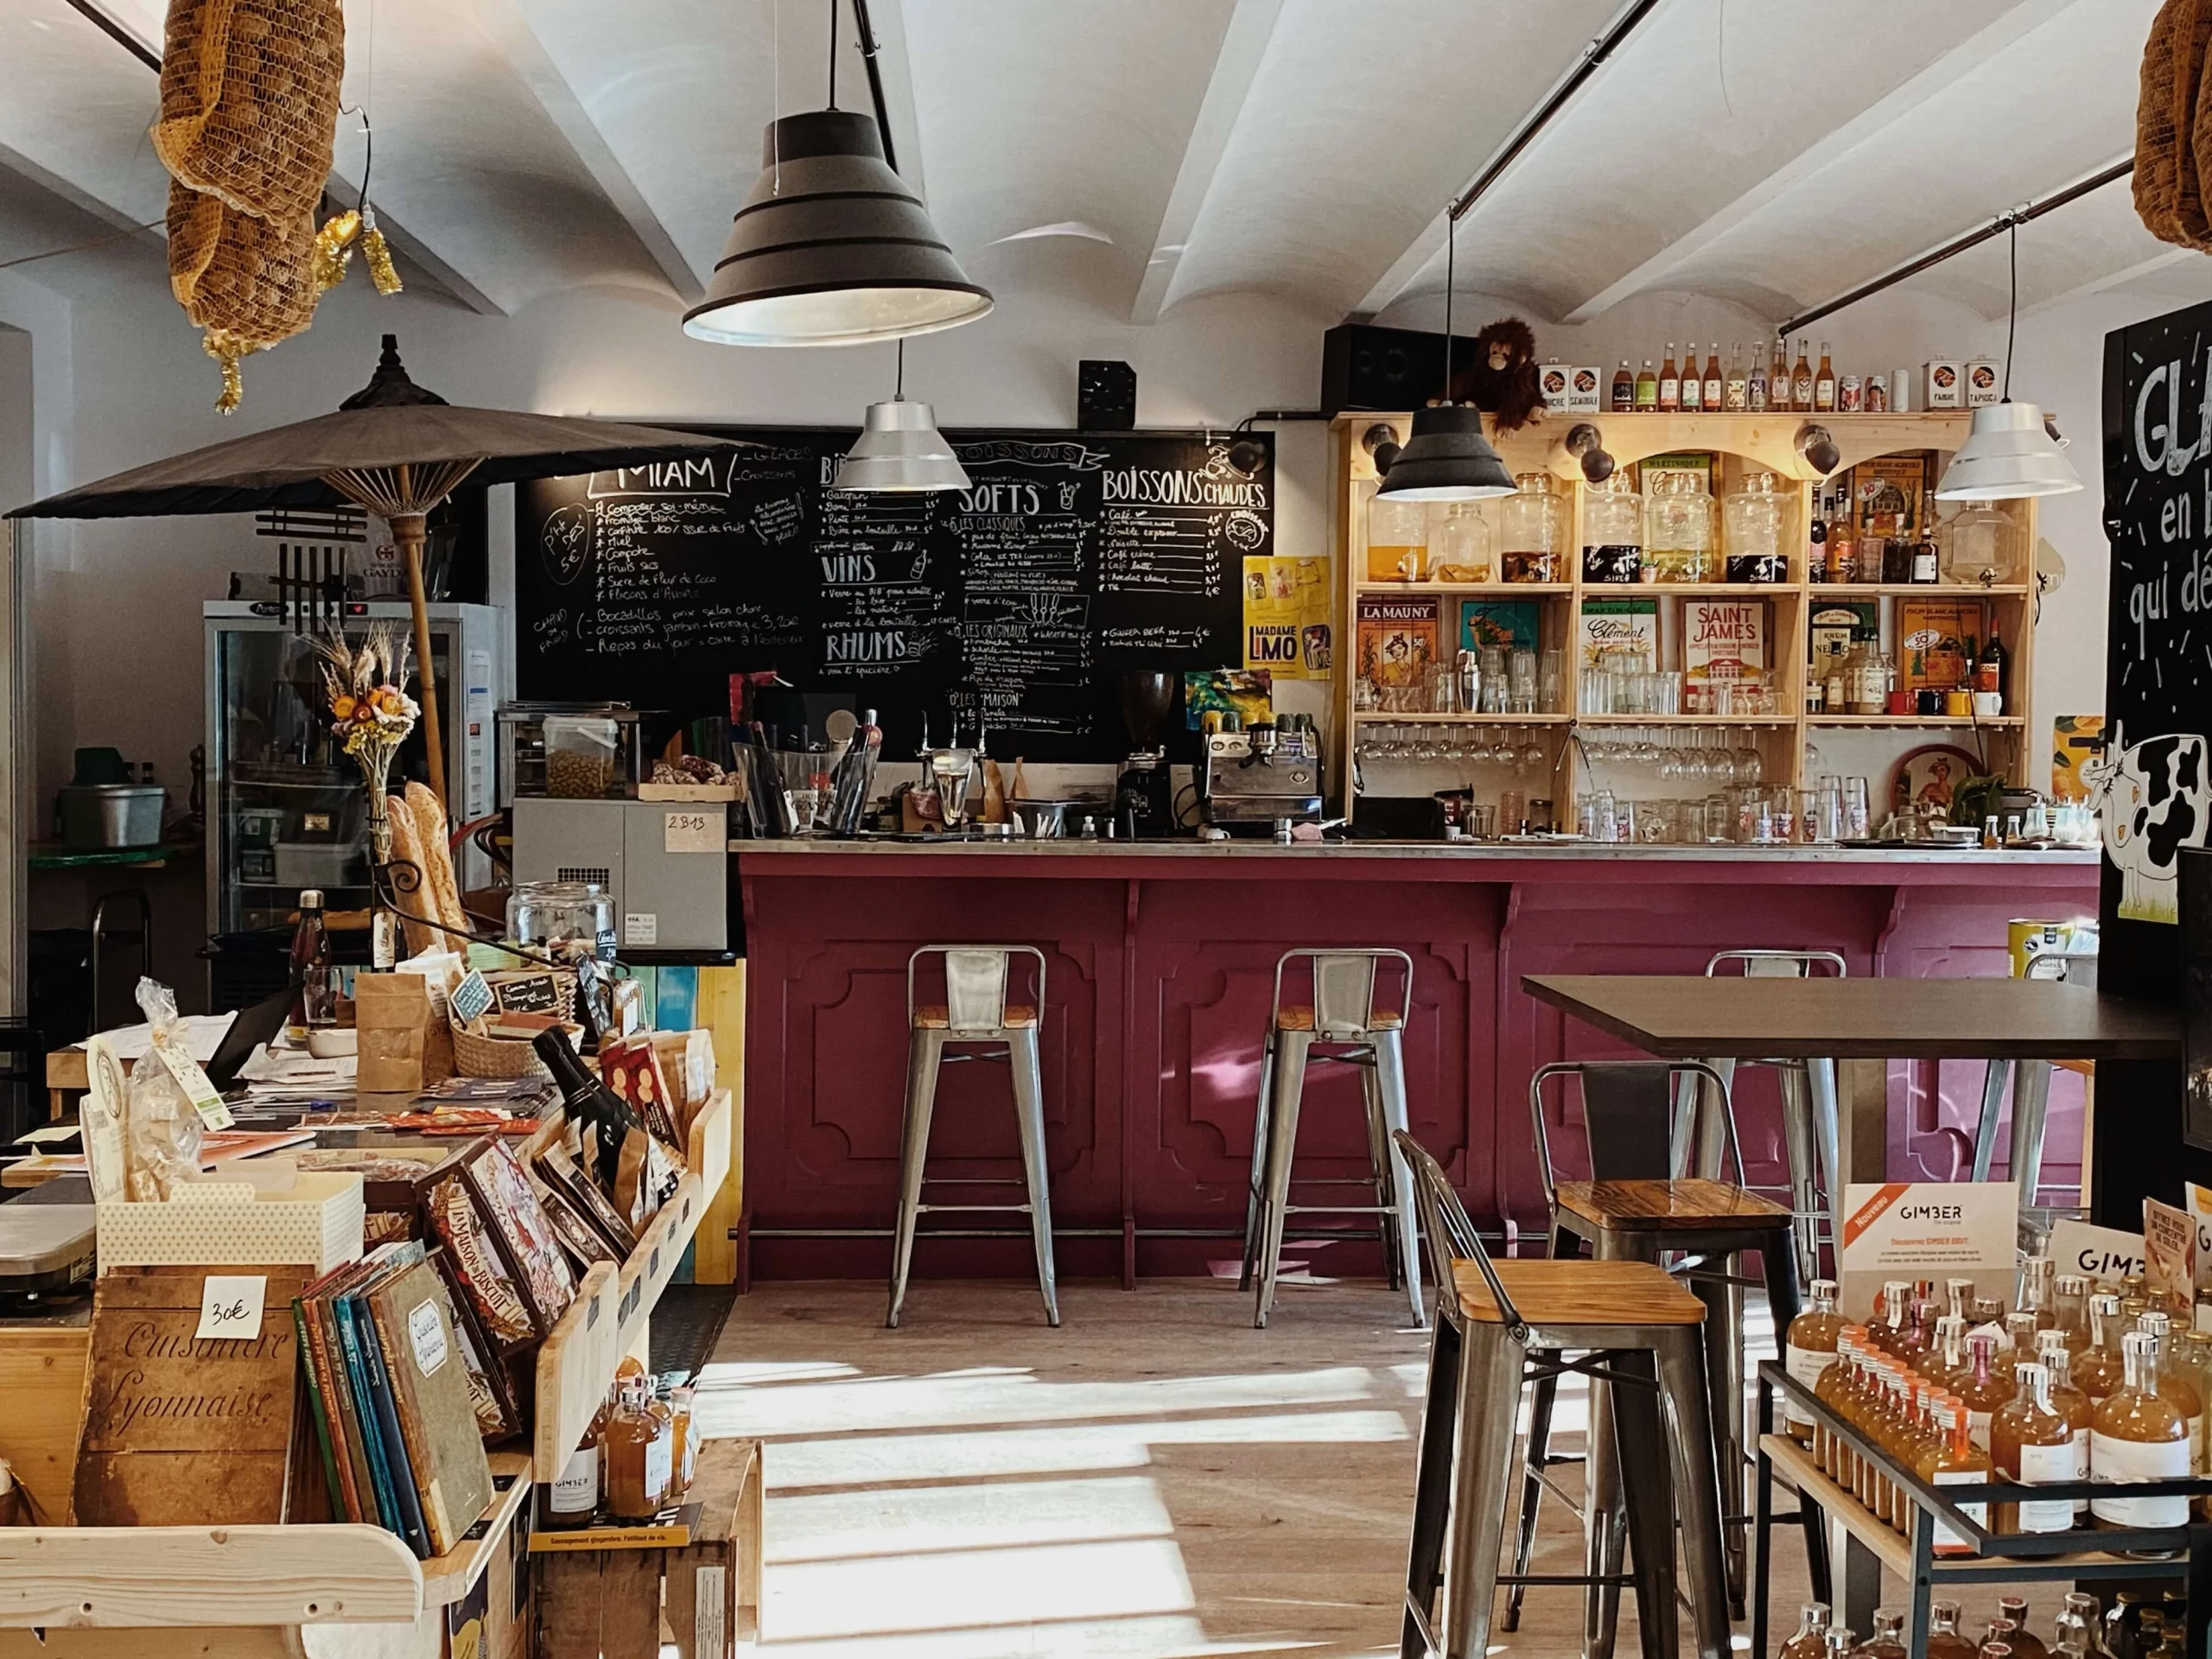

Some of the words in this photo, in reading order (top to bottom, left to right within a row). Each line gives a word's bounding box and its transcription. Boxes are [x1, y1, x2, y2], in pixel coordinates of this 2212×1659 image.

[1103, 467, 1202, 505] BOISSONS
[1204, 483, 1266, 507] CHAUDES
[958, 485, 1039, 515] SOFTS
[1109, 509, 1133, 520] Café
[2161, 492, 2190, 543] en
[960, 518, 973, 531] LES
[976, 518, 1026, 532] CLASSIQUES
[608, 537, 632, 548] Miel
[606, 547, 654, 562] Compote
[970, 552, 992, 561] Cola
[1107, 550, 1128, 559] Café
[608, 563, 634, 573] Fruits
[608, 577, 635, 588] Sucre
[639, 576, 648, 586] de
[680, 575, 691, 584] de
[598, 608, 661, 622] Bocadillos
[673, 610, 694, 621] prix
[702, 605, 731, 616] selon
[1363, 607, 1381, 618] LA
[1382, 607, 1430, 618] MAUNY
[1698, 607, 1753, 624] SAINT
[2130, 561, 2168, 660] qui
[596, 623, 654, 635] croissants
[966, 625, 979, 638] LES
[982, 624, 1027, 639] ORIGINAUX
[1255, 626, 1296, 635] MADAME
[1694, 624, 1756, 642] JAMES
[599, 639, 636, 657] Repas
[643, 639, 662, 650] du
[827, 631, 906, 661] RHUMS
[1249, 626, 1297, 660] LIMO
[961, 693, 975, 707] LES
[453, 1211, 464, 1224] LA
[1854, 1196, 1888, 1228] Nouveau
[1901, 1206, 1961, 1219] GIMBER
[452, 1224, 478, 1268] MAISON
[473, 1270, 512, 1310] BISCUIT
[213, 1299, 250, 1325] 30€
